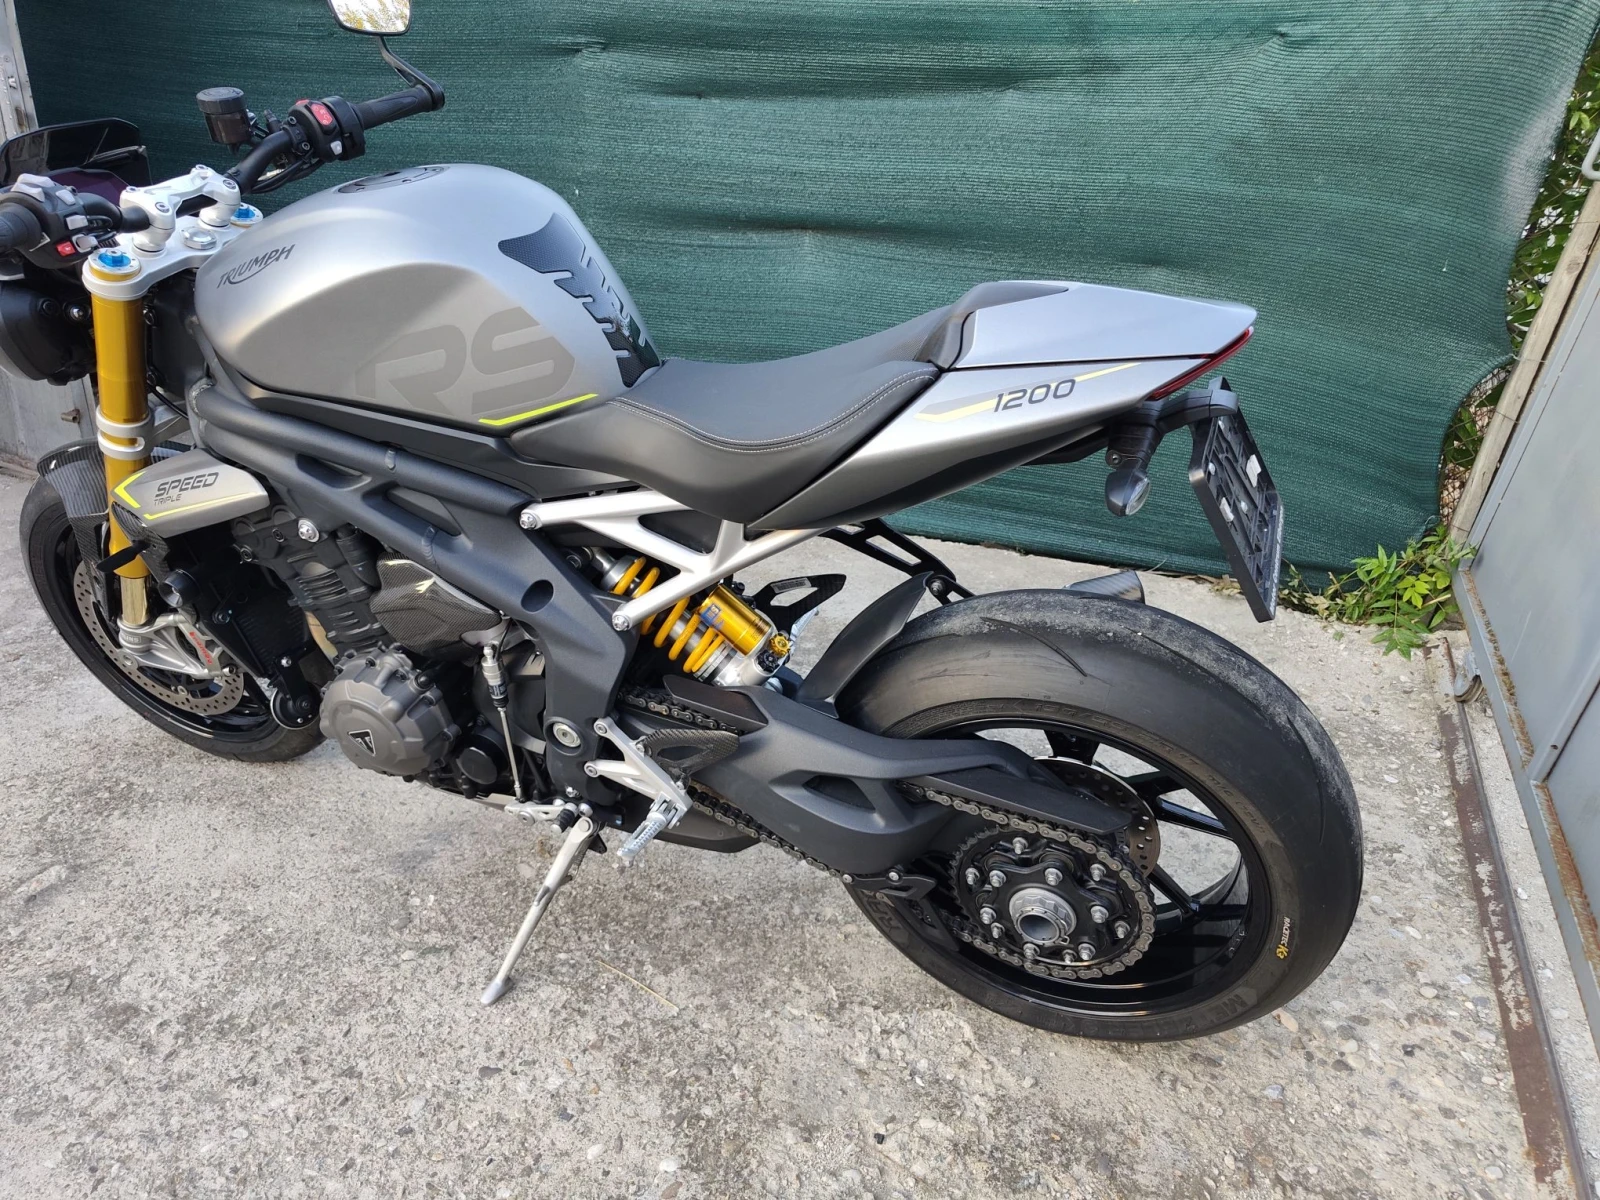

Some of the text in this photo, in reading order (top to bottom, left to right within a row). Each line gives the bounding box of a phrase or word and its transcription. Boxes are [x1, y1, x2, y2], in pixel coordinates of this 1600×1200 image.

[216, 243, 296, 289] TRIUMPH
[354, 306, 576, 417] RS
[993, 378, 1076, 413] 1200
[153, 493, 182, 507] TRIPLE
[154, 472, 219, 498] SPEED
